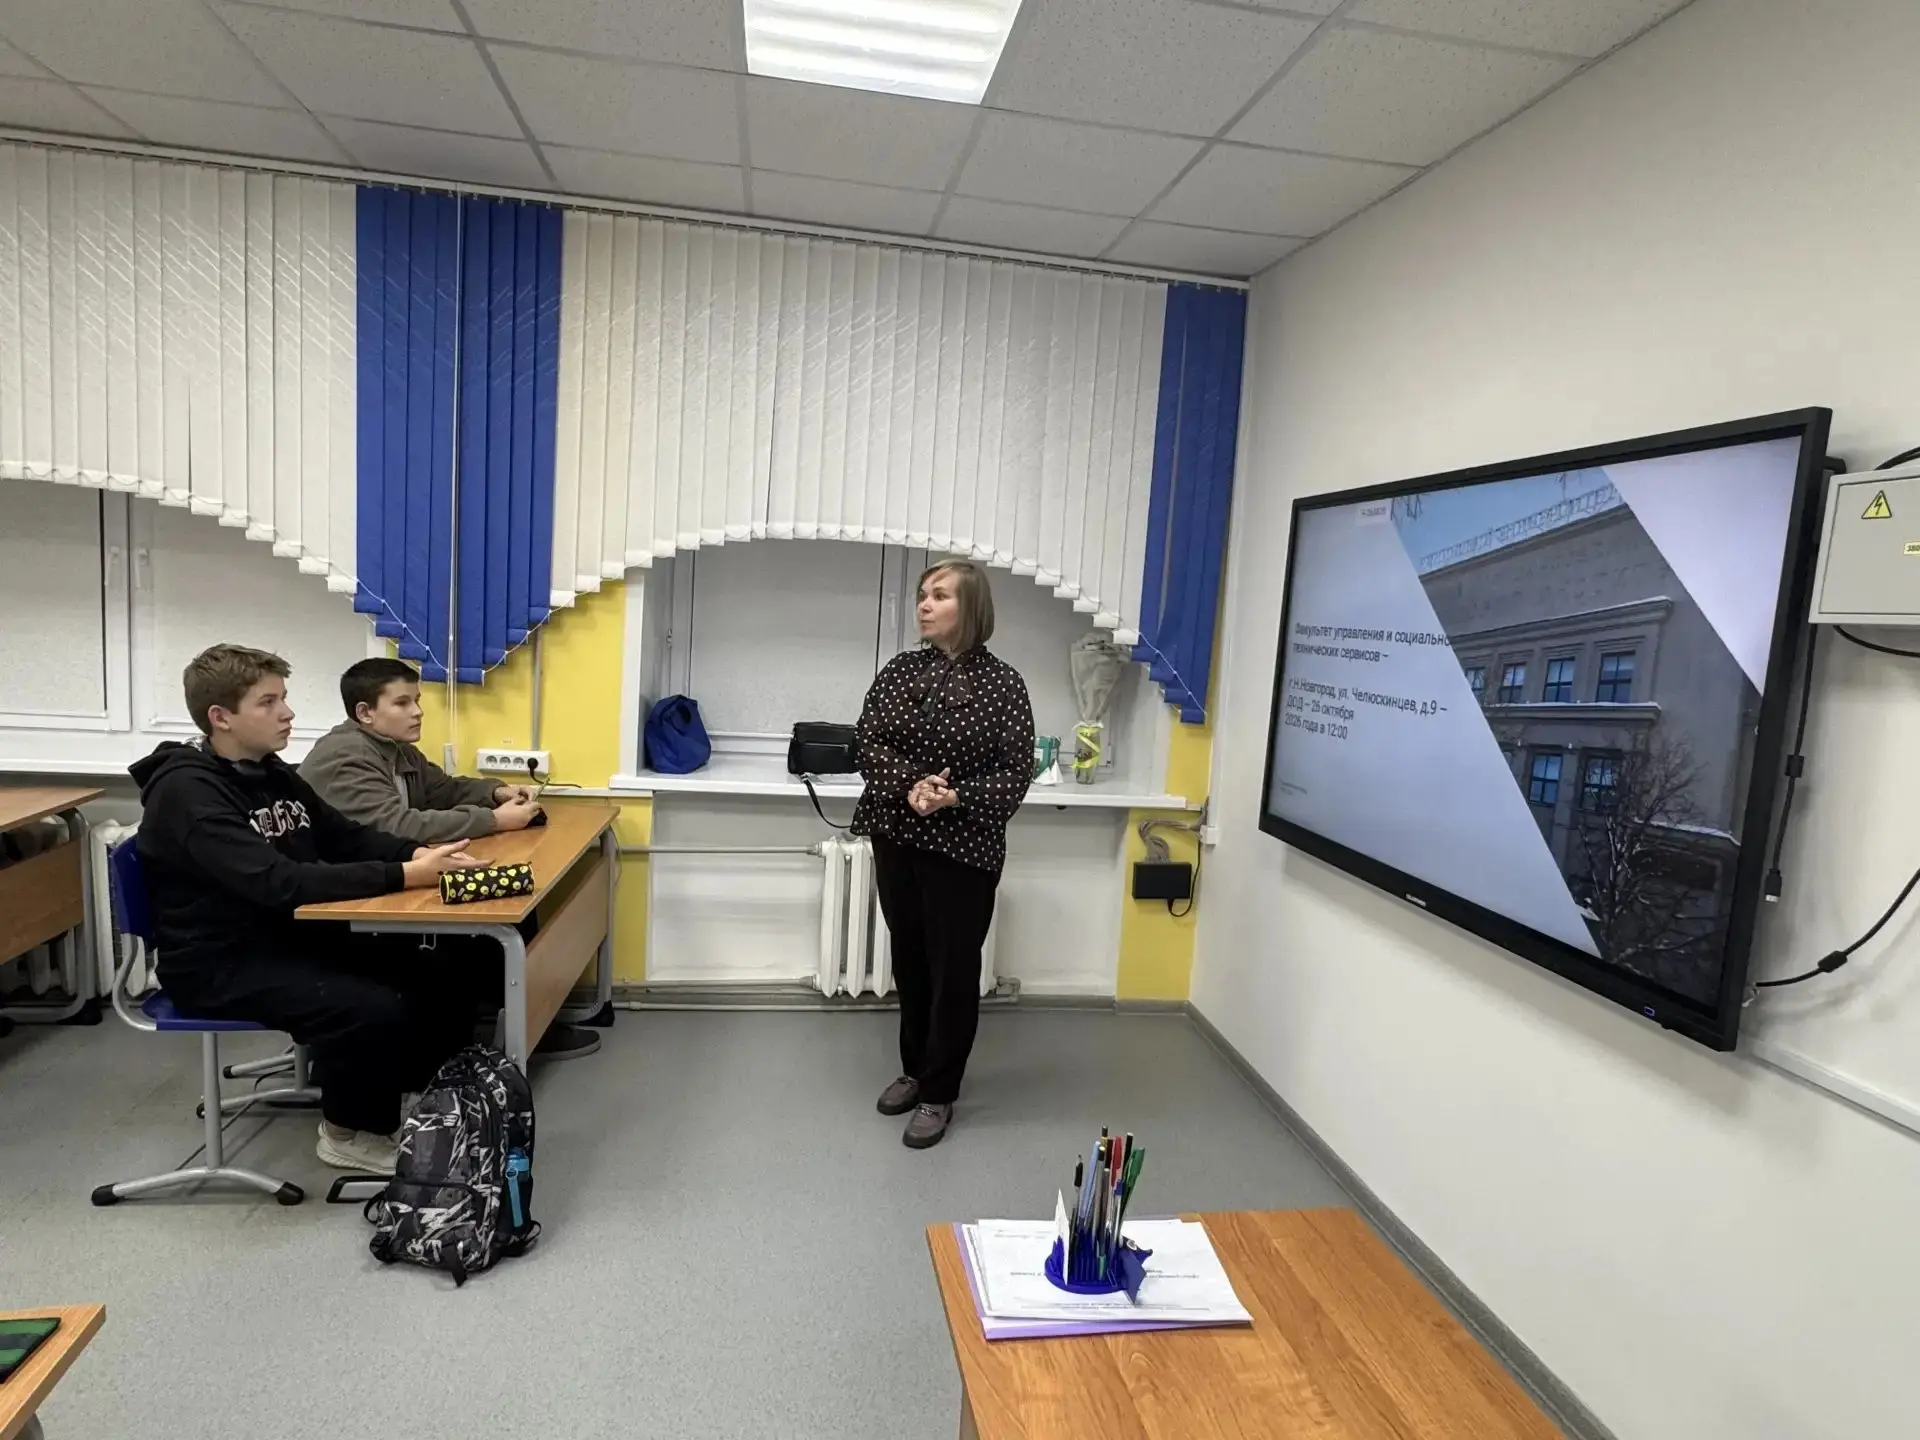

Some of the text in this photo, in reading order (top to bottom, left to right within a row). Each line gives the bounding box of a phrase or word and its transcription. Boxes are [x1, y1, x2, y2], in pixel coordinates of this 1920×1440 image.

[1333, 627, 1384, 641] управления
[1386, 631, 1393, 642] и
[1293, 643, 1339, 658] технических
[1341, 647, 1380, 662] сервисов
[1338, 688, 1349, 701] ул.
[1352, 688, 1417, 715] Челюскинцев,
[1420, 700, 1437, 717] д.9
[1321, 705, 1354, 722] октября
[1302, 719, 1319, 733] года
[1320, 723, 1326, 734] в
[1327, 723, 1348, 740] 12:00
